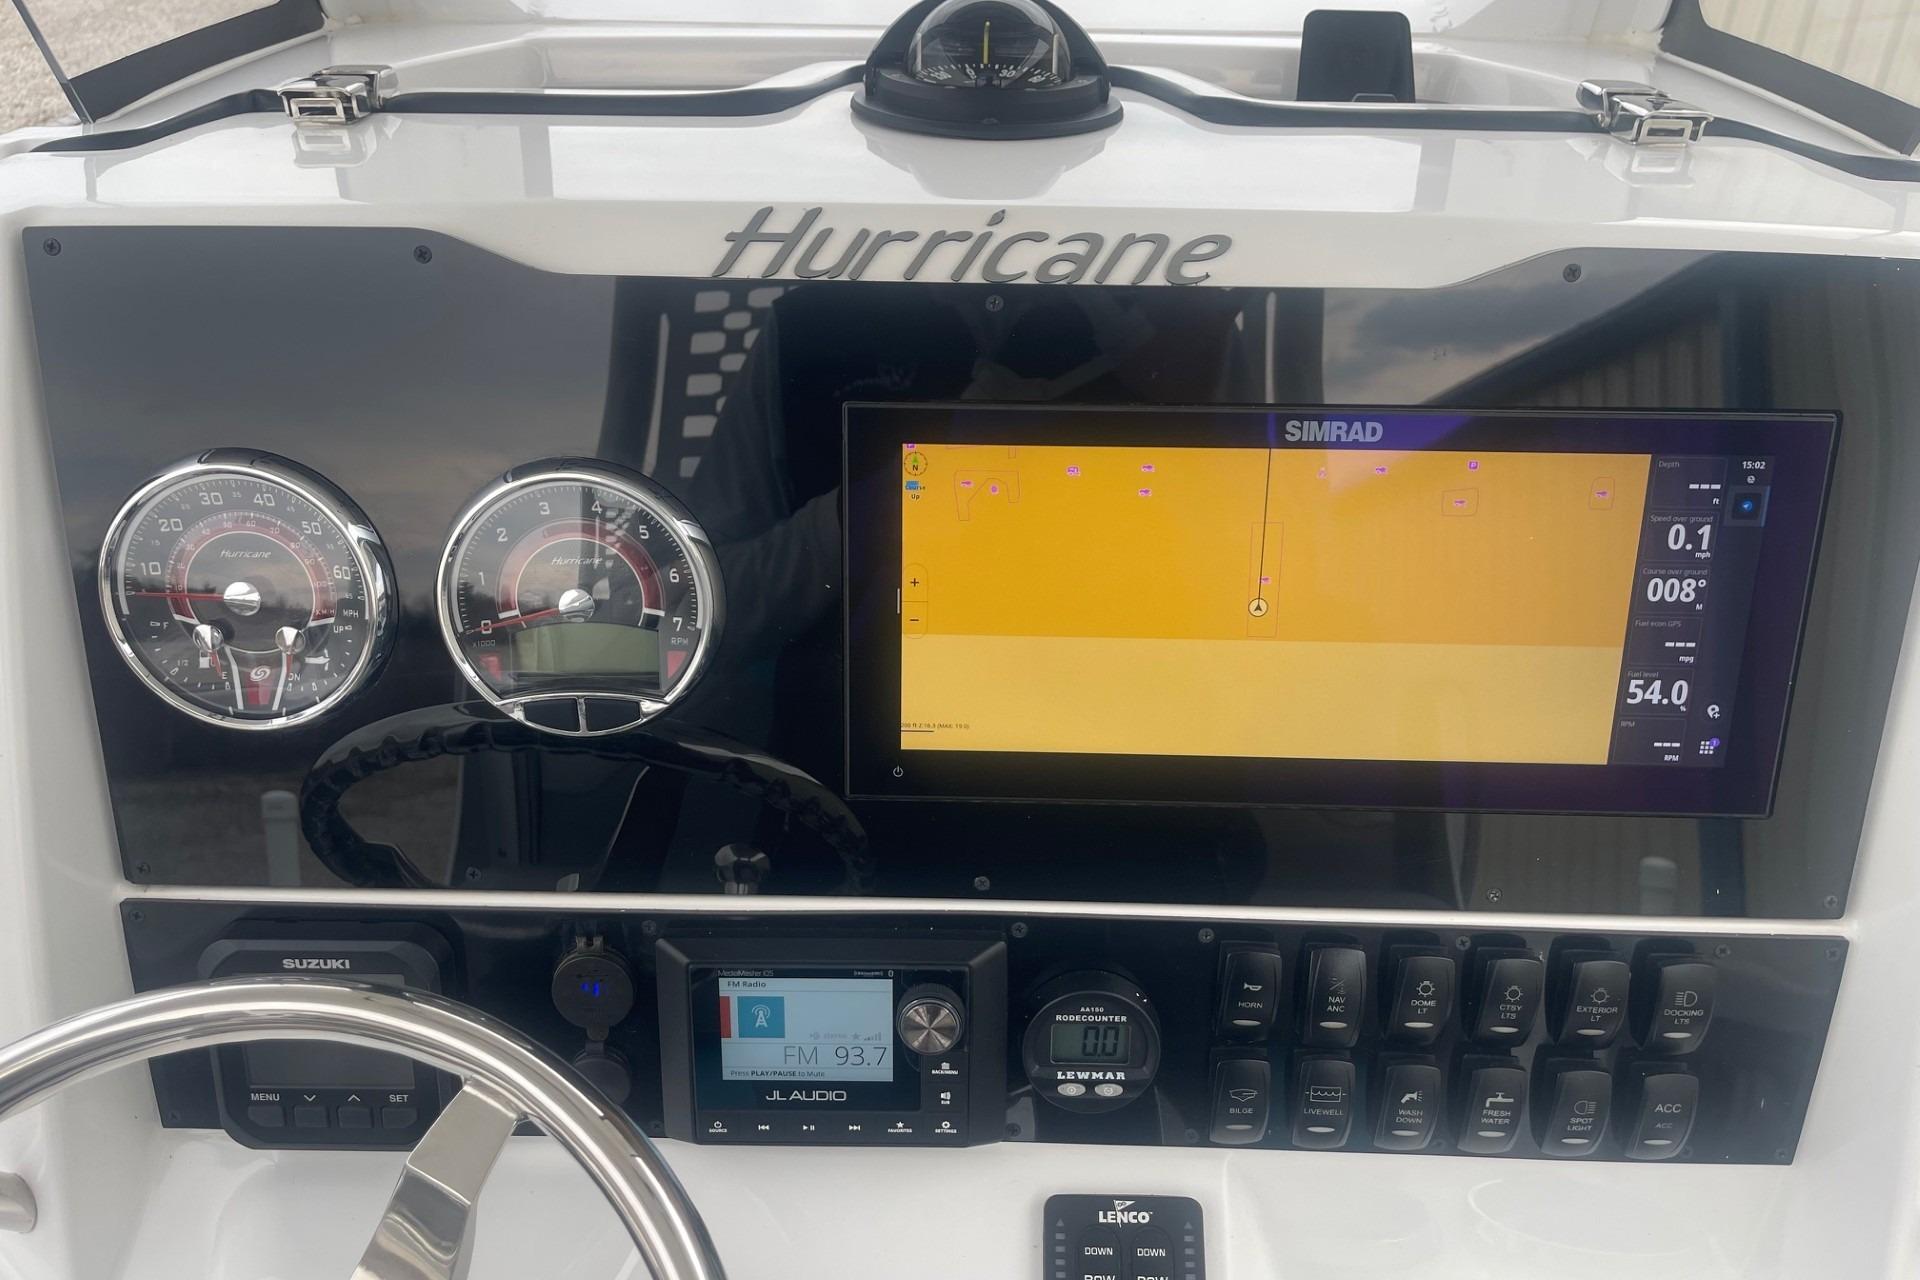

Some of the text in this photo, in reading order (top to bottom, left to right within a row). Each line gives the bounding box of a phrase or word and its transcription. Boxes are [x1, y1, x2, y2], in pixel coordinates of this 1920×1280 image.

[999, 69, 1017, 78] 30
[712, 206, 1233, 285] Hurricane
[1284, 420, 1384, 442] SIMRAD
[1658, 460, 1680, 470] Depth
[1742, 461, 1766, 470] 15:02
[199, 492, 223, 505] 30
[253, 493, 276, 507] 40
[911, 493, 920, 501] Up
[1712, 497, 1720, 505] ft
[539, 502, 550, 515] 3
[591, 500, 602, 514] 4
[1650, 514, 1672, 524] Speed
[1689, 515, 1714, 524] ground
[159, 518, 183, 532] 20
[302, 521, 322, 535] 50
[496, 528, 508, 542] 2
[639, 525, 649, 539] 5
[1666, 523, 1712, 551] 0.1
[219, 549, 272, 560] Hurricane
[1695, 551, 1711, 560] mph
[551, 556, 603, 567] Hurricane
[141, 562, 161, 576] 10
[333, 565, 351, 580] 60
[1643, 567, 1666, 576] Course
[1683, 568, 1708, 578] ground
[478, 571, 486, 586] 1
[669, 568, 680, 583] 6
[343, 609, 359, 619] MPH
[162, 621, 169, 629] F
[481, 620, 492, 635] 0
[672, 617, 683, 631] 7
[1635, 620, 1648, 628] Fuel
[1668, 620, 1682, 628] GPS
[333, 625, 344, 634] UP
[671, 637, 689, 646] RPM
[1679, 655, 1694, 664] mpg
[221, 671, 228, 680] E
[288, 672, 301, 681] DN
[1628, 670, 1659, 678] Fuel level
[1626, 678, 1689, 706] 54.0
[1620, 720, 1636, 728] RPM
[1663, 754, 1680, 762] RPM
[282, 958, 351, 969] SUZUKI
[728, 980, 767, 988] FM Radio
[1328, 996, 1346, 1004] NAV
[1410, 999, 1437, 1007] DOME
[1238, 1001, 1263, 1009] HORN
[1327, 1005, 1345, 1013] ANC
[1500, 1004, 1523, 1012] CTSY
[1576, 1005, 1618, 1014] EXTERIOR
[1501, 1012, 1517, 1020] LTS
[1663, 1008, 1704, 1017] DOCKING
[1055, 1014, 1128, 1022] RODECOUNTER
[1674, 1017, 1690, 1025] LTS
[783, 1046, 888, 1067] FM 93.7
[1056, 1071, 1126, 1080] LEWMAR
[251, 1092, 280, 1101] MENU
[389, 1094, 409, 1102] SET
[766, 1090, 847, 1101] JL AUDIO
[1303, 1108, 1345, 1116] LIVEWELL
[1654, 1103, 1682, 1113] ACC
[1398, 1109, 1424, 1117] WASH
[1482, 1109, 1511, 1117] FRESH
[1395, 1116, 1423, 1124] DOWN
[1480, 1117, 1511, 1125] WATER
[1098, 1210, 1150, 1224] LENCO
[1084, 1247, 1113, 1256] DOWN
[1137, 1248, 1166, 1257] DOWN
